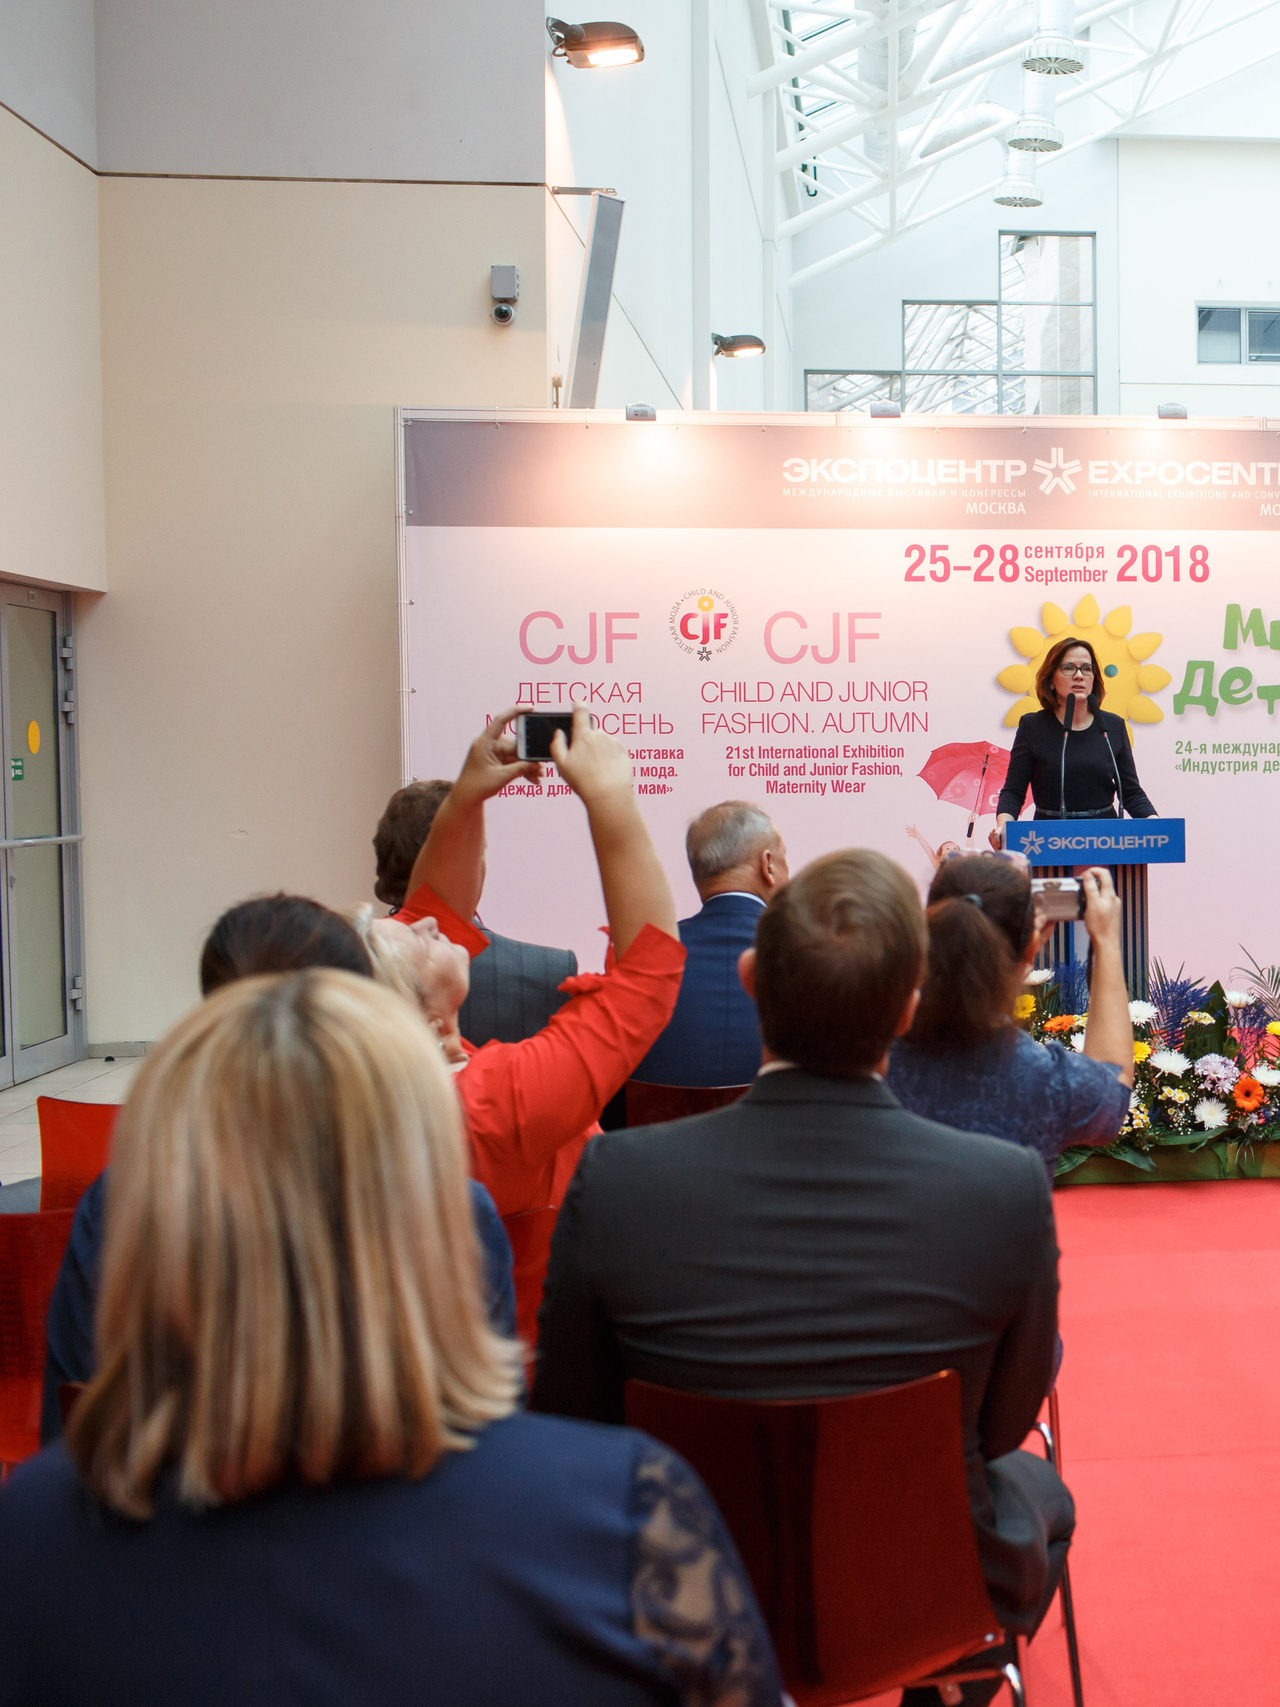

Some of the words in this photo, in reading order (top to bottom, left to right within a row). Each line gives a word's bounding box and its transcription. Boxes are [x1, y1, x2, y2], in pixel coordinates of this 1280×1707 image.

[782, 457, 1027, 487] ЭКСПОЦЕНТР
[782, 487, 882, 499] МЕЖДУНАРОДНЫЕ
[887, 487, 946, 498] ВЫСТАВКИ
[950, 488, 957, 498] И
[962, 489, 1026, 499] КОНГРЕССЫ
[1088, 489, 1164, 499] INTERNATIONAL
[1167, 489, 1228, 499] EXHIBITIONS
[1231, 490, 1251, 500] AND
[965, 502, 1026, 515] МОСКВА
[1024, 542, 1105, 562] сентября
[1116, 544, 1210, 583] 2018
[1024, 565, 1108, 586] September
[684, 588, 706, 600] CHILD
[708, 589, 725, 600] AND
[669, 601, 681, 625] МОДА
[724, 599, 739, 625] JUNIOR
[518, 610, 640, 665] CJF
[669, 626, 695, 654] ДЕТСКАЯ
[715, 627, 739, 654] FASHION
[763, 610, 882, 665] CJF
[516, 682, 642, 706] ДЕТСКАЯ
[701, 681, 775, 703] CHILD
[780, 681, 833, 702] AND
[839, 680, 928, 702] JUNIOR
[702, 711, 815, 734] FASHION.
[822, 711, 929, 733] AUTUMN
[628, 748, 684, 760] ыставка
[725, 745, 755, 760] 21st
[758, 745, 839, 760] International
[843, 744, 905, 759] Exhibition
[1175, 740, 1208, 755] 24-я
[640, 767, 678, 779] мода.
[728, 763, 746, 777] for
[749, 762, 780, 777] Child
[783, 762, 806, 776] and
[809, 762, 849, 776] Junior
[851, 761, 903, 778] Fashion,
[1174, 757, 1259, 775] «Индустрия
[499, 784, 543, 797] дежда
[547, 784, 573, 797] для
[638, 784, 674, 795] мам»
[766, 780, 827, 796] Maternity
[831, 779, 866, 793] Wear
[1048, 834, 1169, 850] ЭКСПОЦЕНТР
